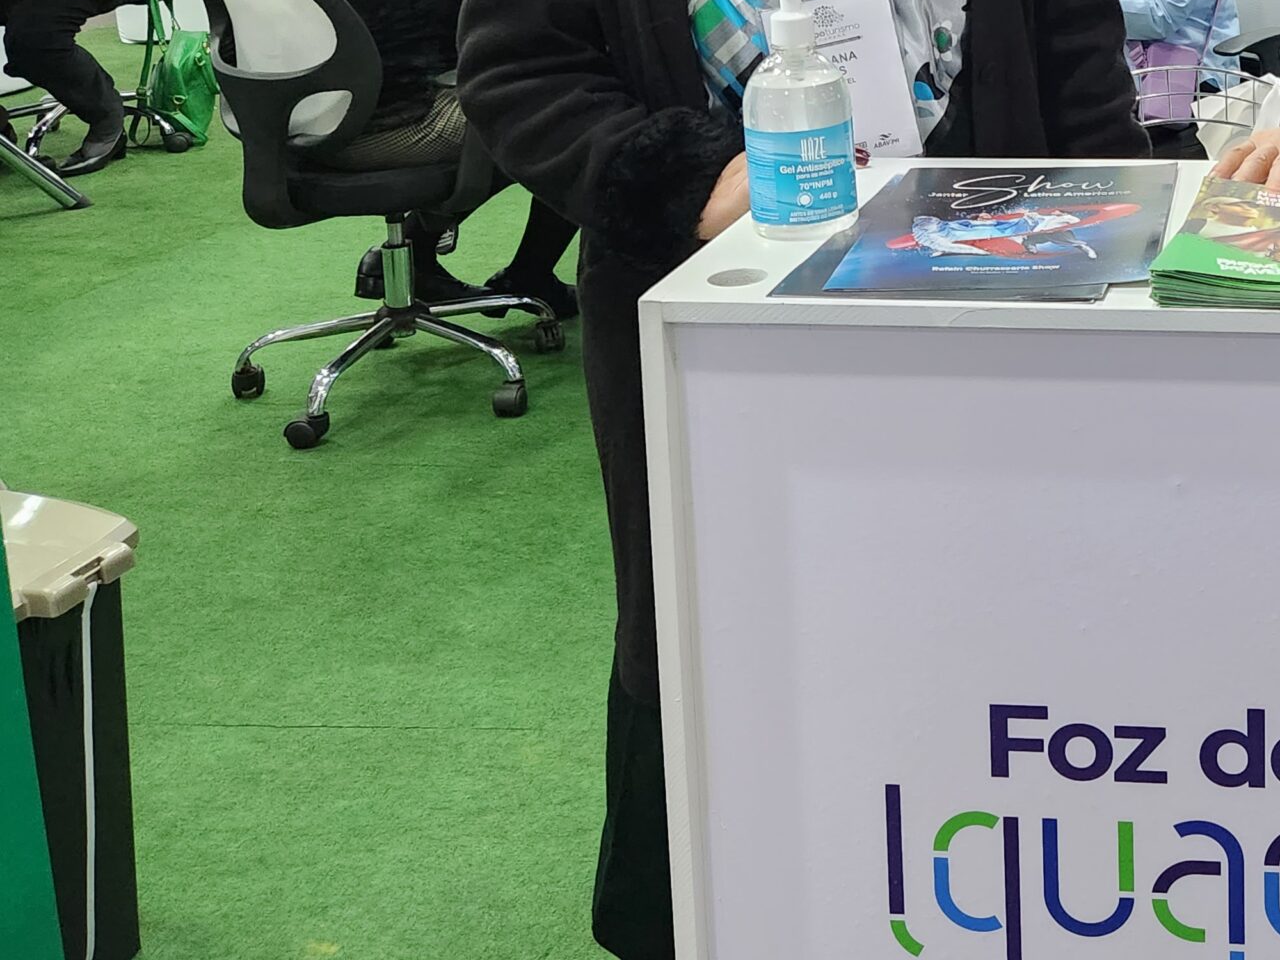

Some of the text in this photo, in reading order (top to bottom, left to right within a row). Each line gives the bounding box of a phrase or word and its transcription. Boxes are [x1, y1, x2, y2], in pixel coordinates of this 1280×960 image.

[801, 136, 828, 162] HAZE
[779, 165, 796, 175] Gel
[950, 174, 1116, 209] Show
[988, 703, 1169, 785] Foz
